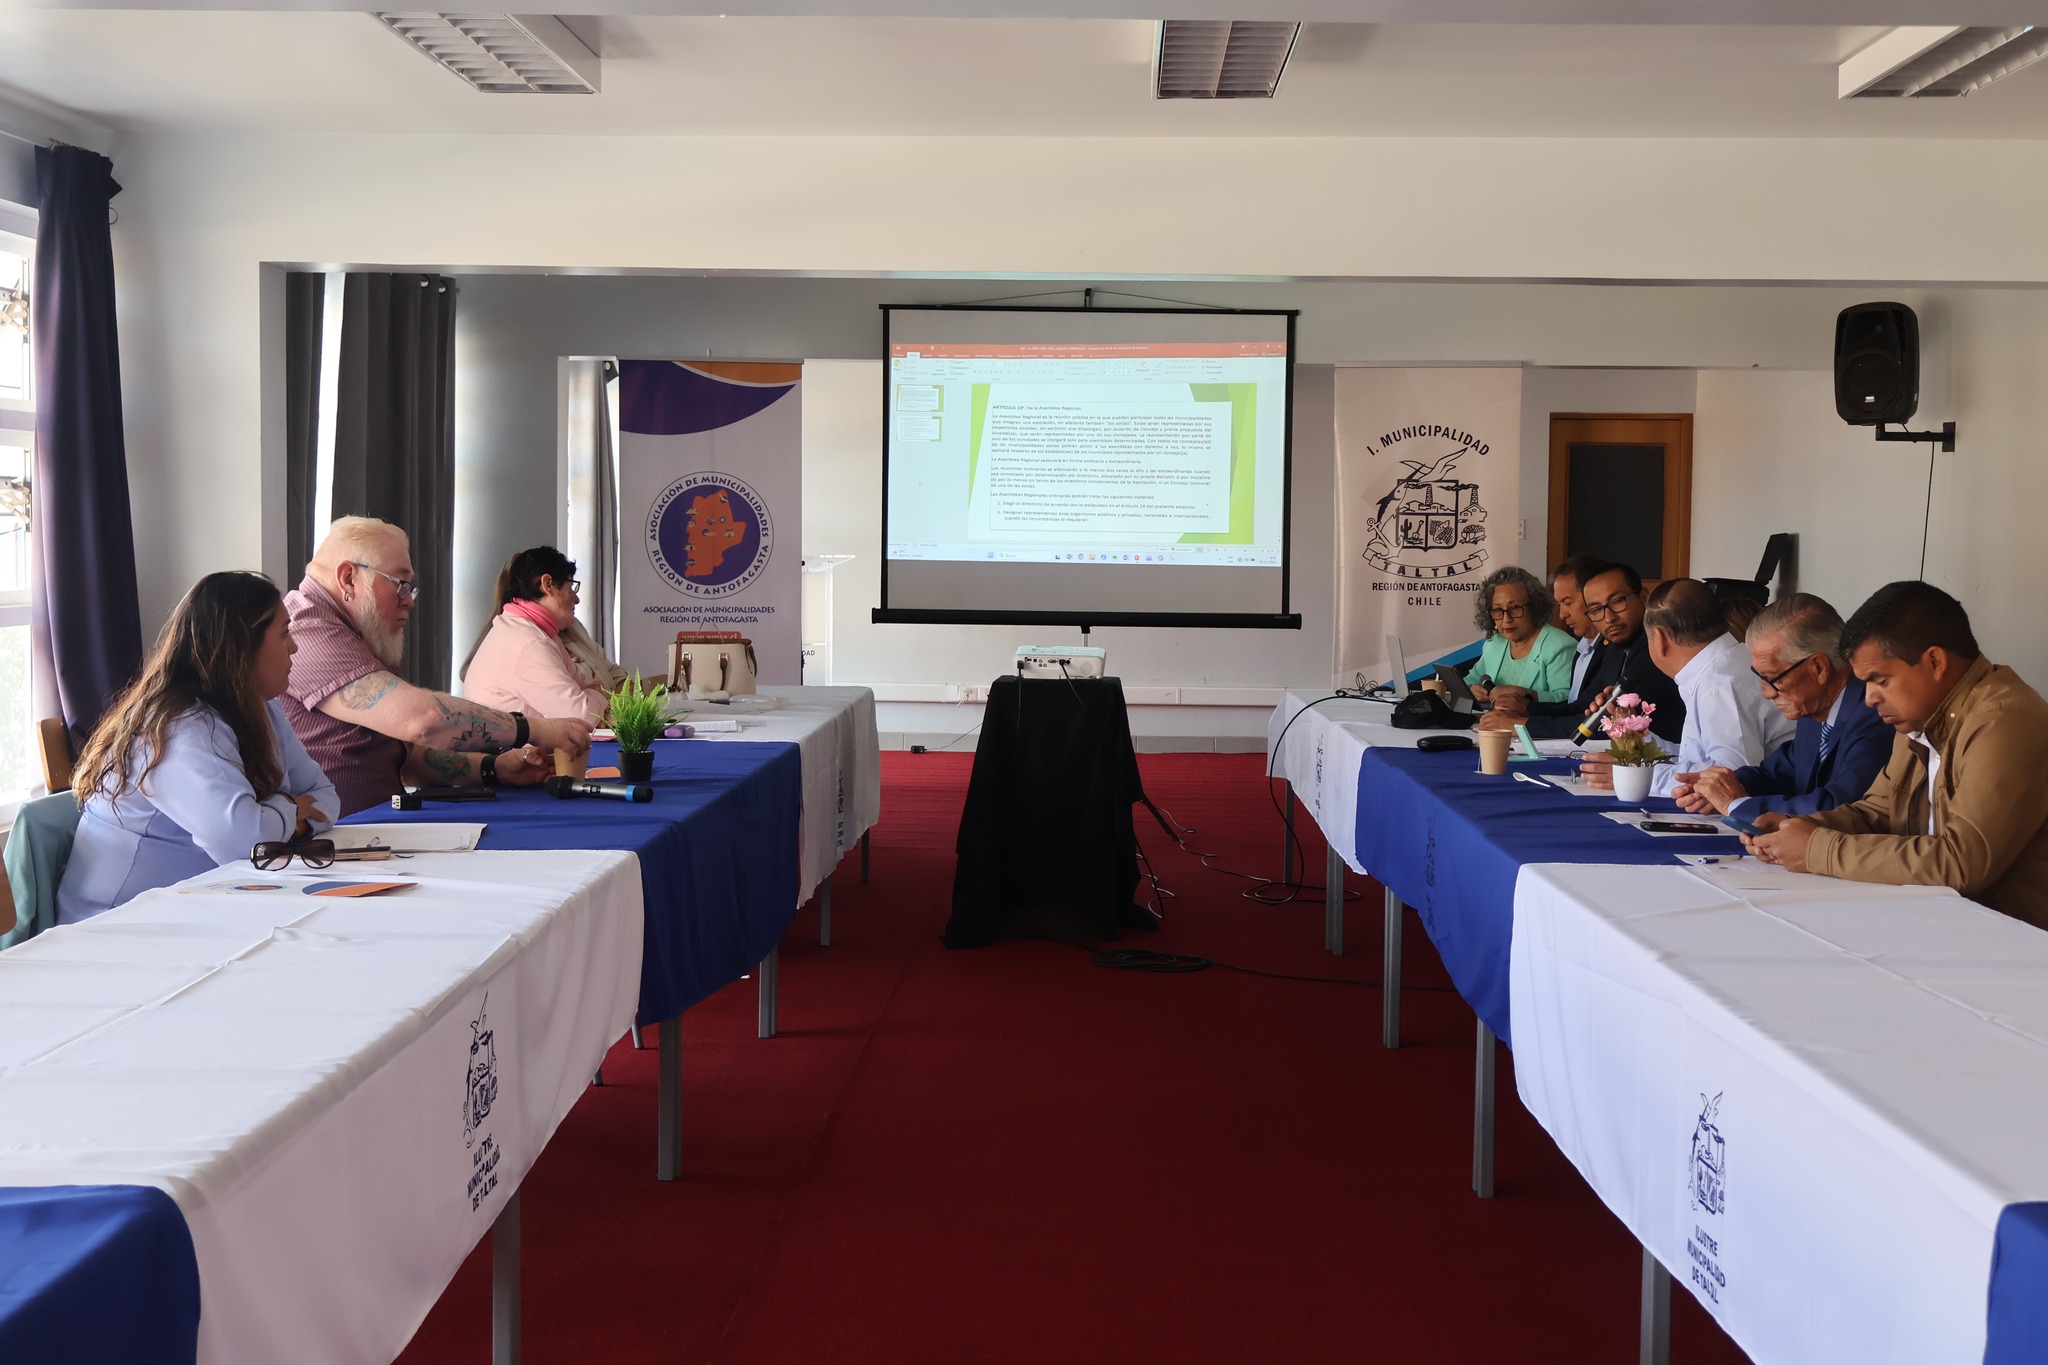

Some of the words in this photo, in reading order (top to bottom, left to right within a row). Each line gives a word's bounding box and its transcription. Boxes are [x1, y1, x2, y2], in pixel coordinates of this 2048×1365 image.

[1380, 425, 1490, 456] MUNICIPALIDAD
[650, 484, 684, 540] ASOCIACIÓN
[685, 476, 698, 487] DE
[701, 476, 769, 537] MUNICIPALIDADES
[652, 550, 683, 586] REGIÓN
[686, 584, 700, 593] DE
[703, 545, 769, 595] ANTOFAGASTA
[1384, 562, 1472, 577] TALTAL
[1373, 581, 1404, 591] REGIÓN
[1420, 583, 1481, 591] ANTOFAGASTA
[1408, 597, 1442, 605] CHILE
[1695, 1224, 1718, 1257] ILUSTRE
[1692, 1266, 1699, 1284] DE
